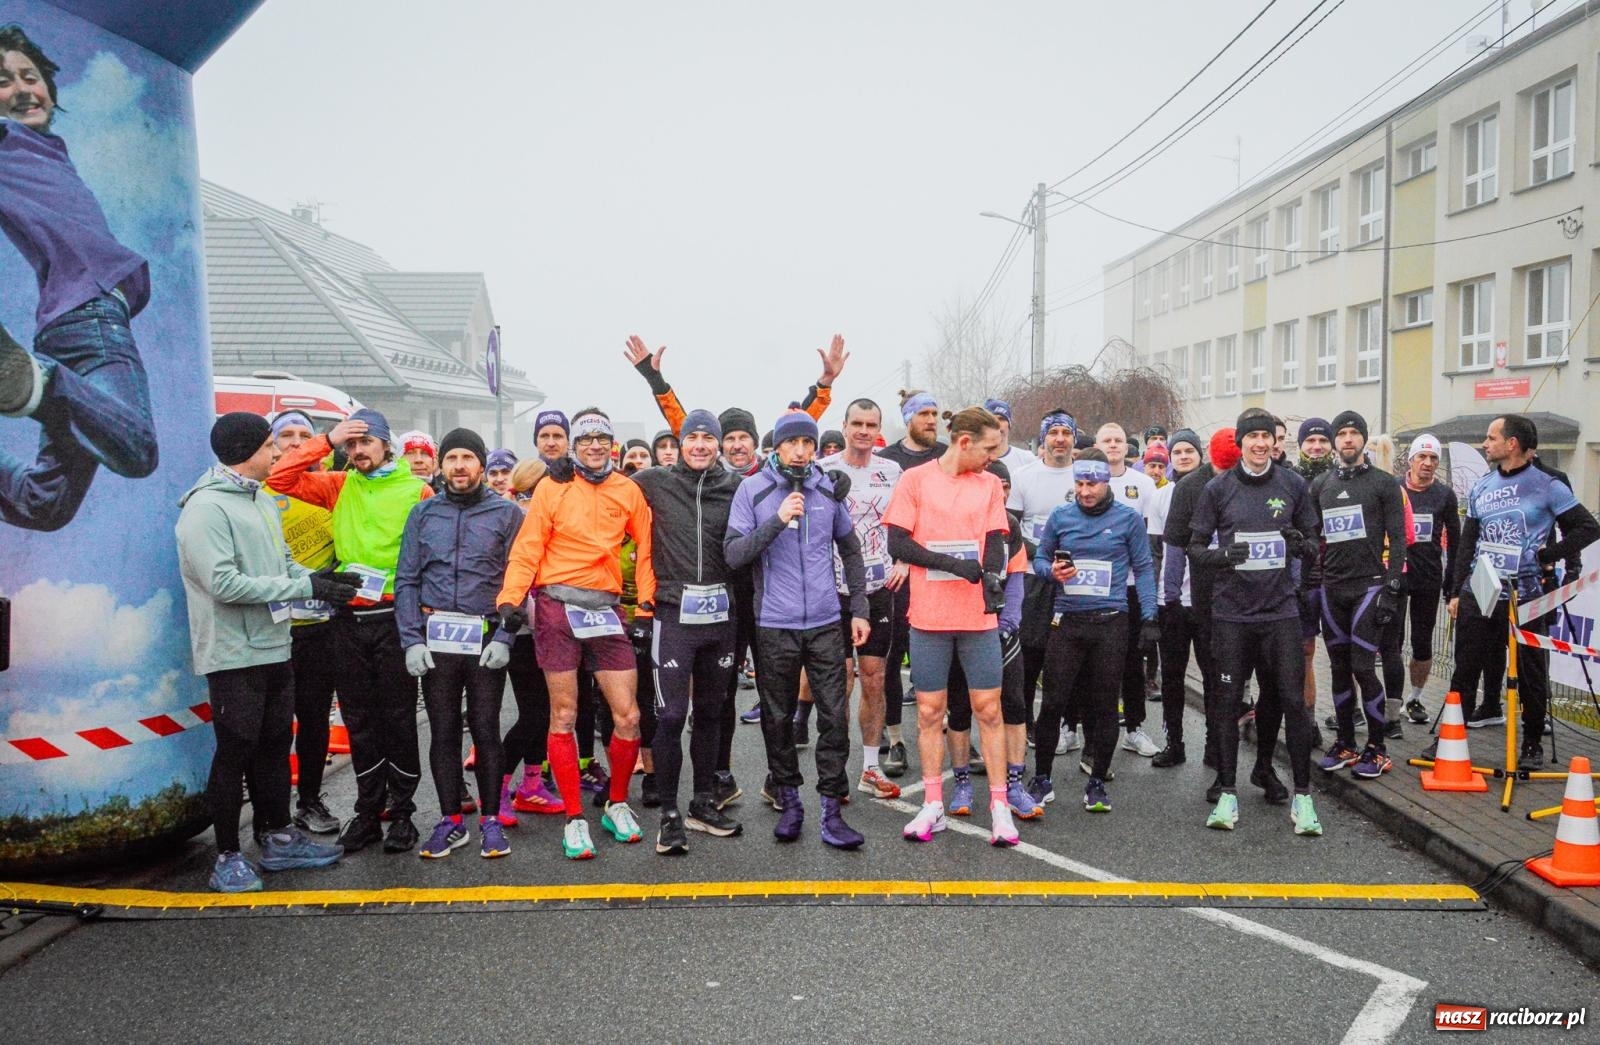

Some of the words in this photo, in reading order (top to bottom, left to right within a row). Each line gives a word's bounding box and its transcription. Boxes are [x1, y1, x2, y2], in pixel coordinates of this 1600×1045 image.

[1475, 484, 1519, 507] MORSY
[1328, 515, 1355, 533] 137
[1248, 541, 1278, 559] 191
[1076, 570, 1097, 585] 93
[696, 596, 718, 614] 23
[582, 611, 607, 626] 48
[436, 622, 474, 642] 177
